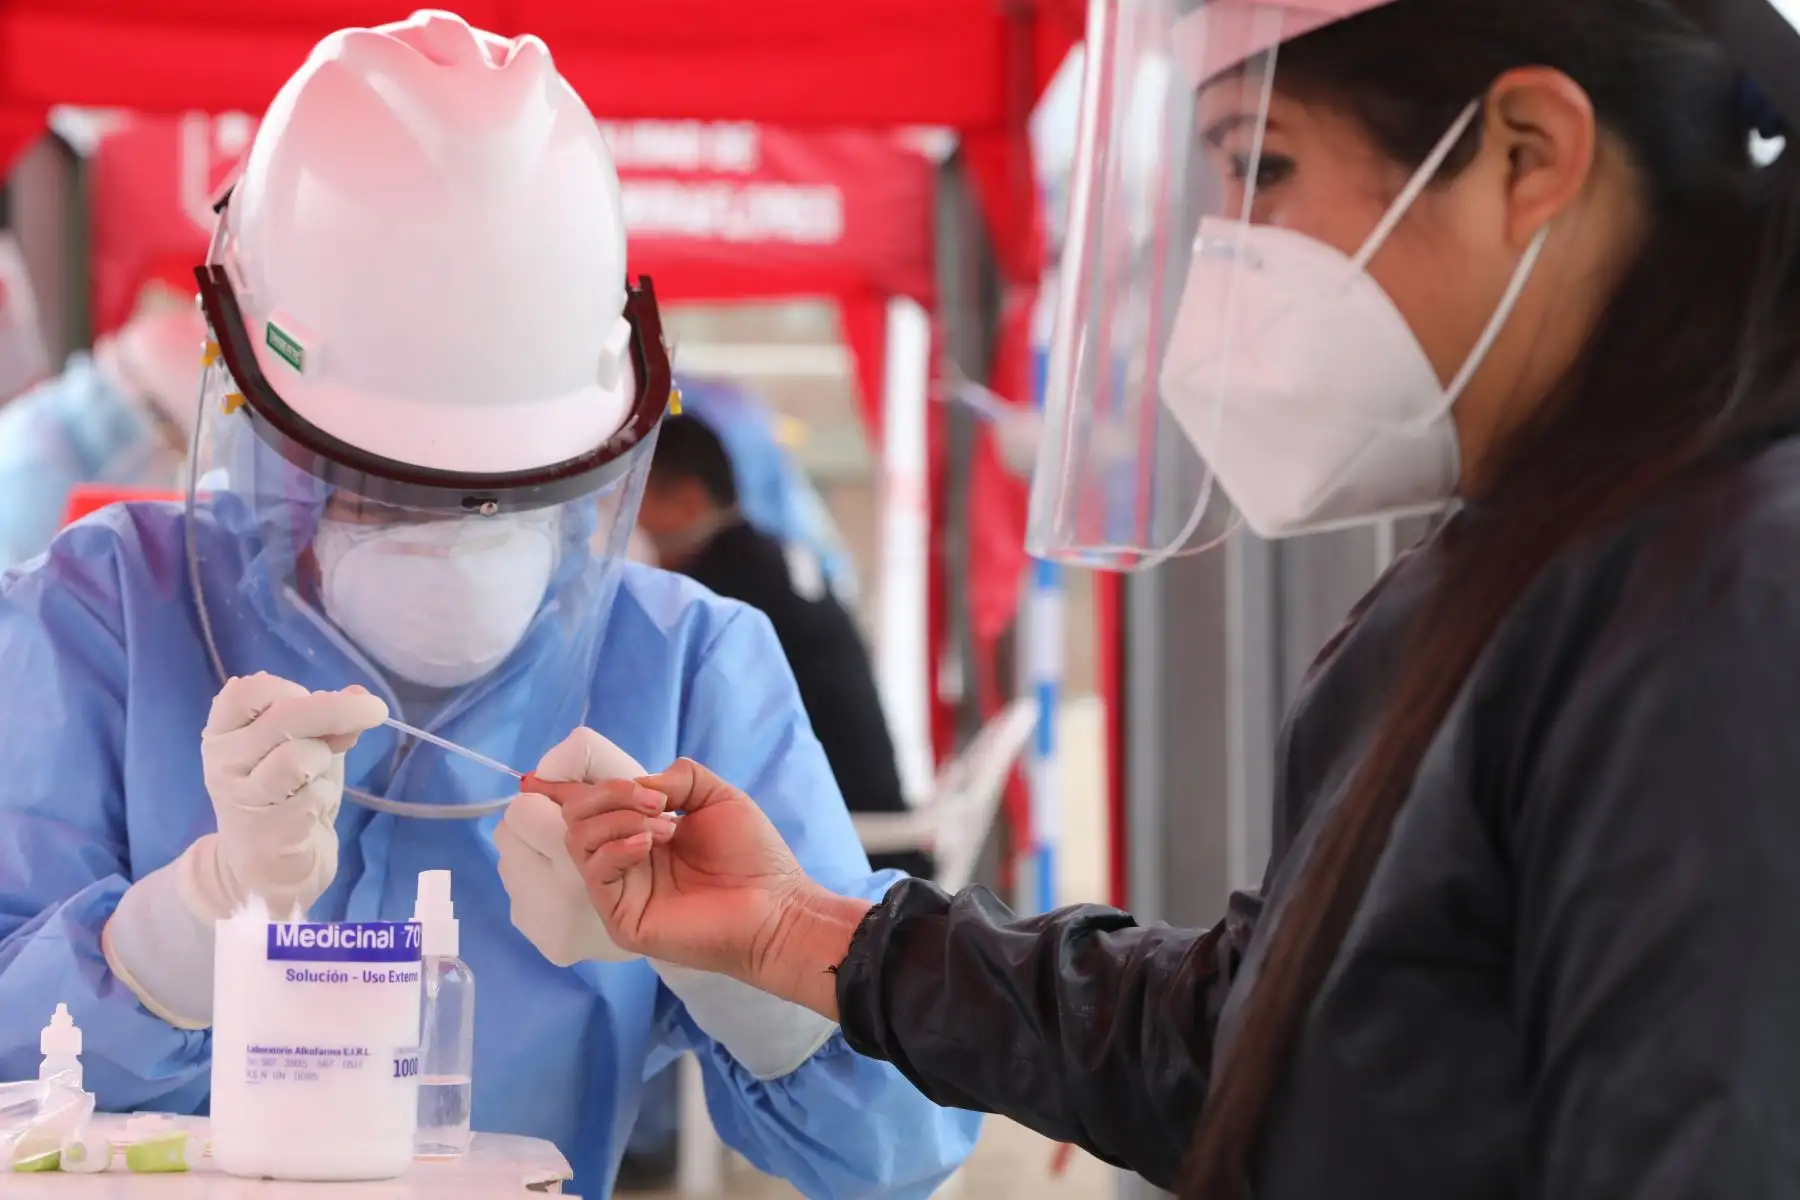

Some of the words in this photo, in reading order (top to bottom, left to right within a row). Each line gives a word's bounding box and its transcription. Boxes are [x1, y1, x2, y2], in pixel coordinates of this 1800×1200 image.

[275, 924, 395, 948] Medicinal
[286, 967, 348, 983] Solución
[362, 969, 386, 984] Uso
[246, 1044, 293, 1056] Laboratorio
